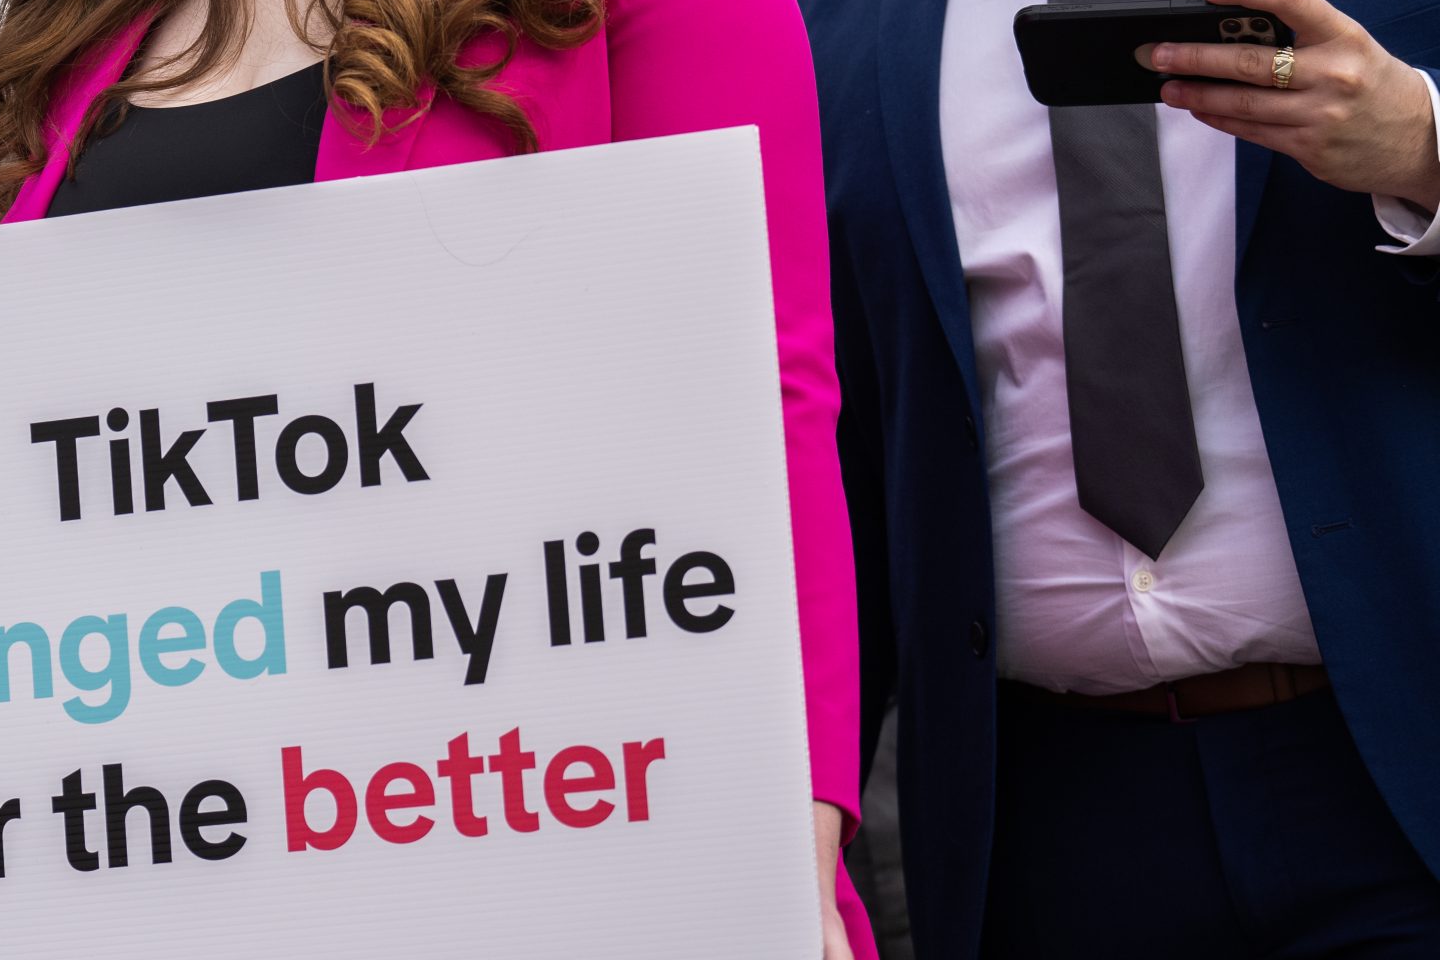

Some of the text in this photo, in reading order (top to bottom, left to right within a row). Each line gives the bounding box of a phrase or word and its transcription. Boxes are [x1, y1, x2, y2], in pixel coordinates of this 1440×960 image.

[29, 382, 431, 522] TikTok
[322, 581, 509, 686] my
[543, 527, 736, 647] life
[51, 762, 248, 873] the
[280, 726, 666, 853] better
